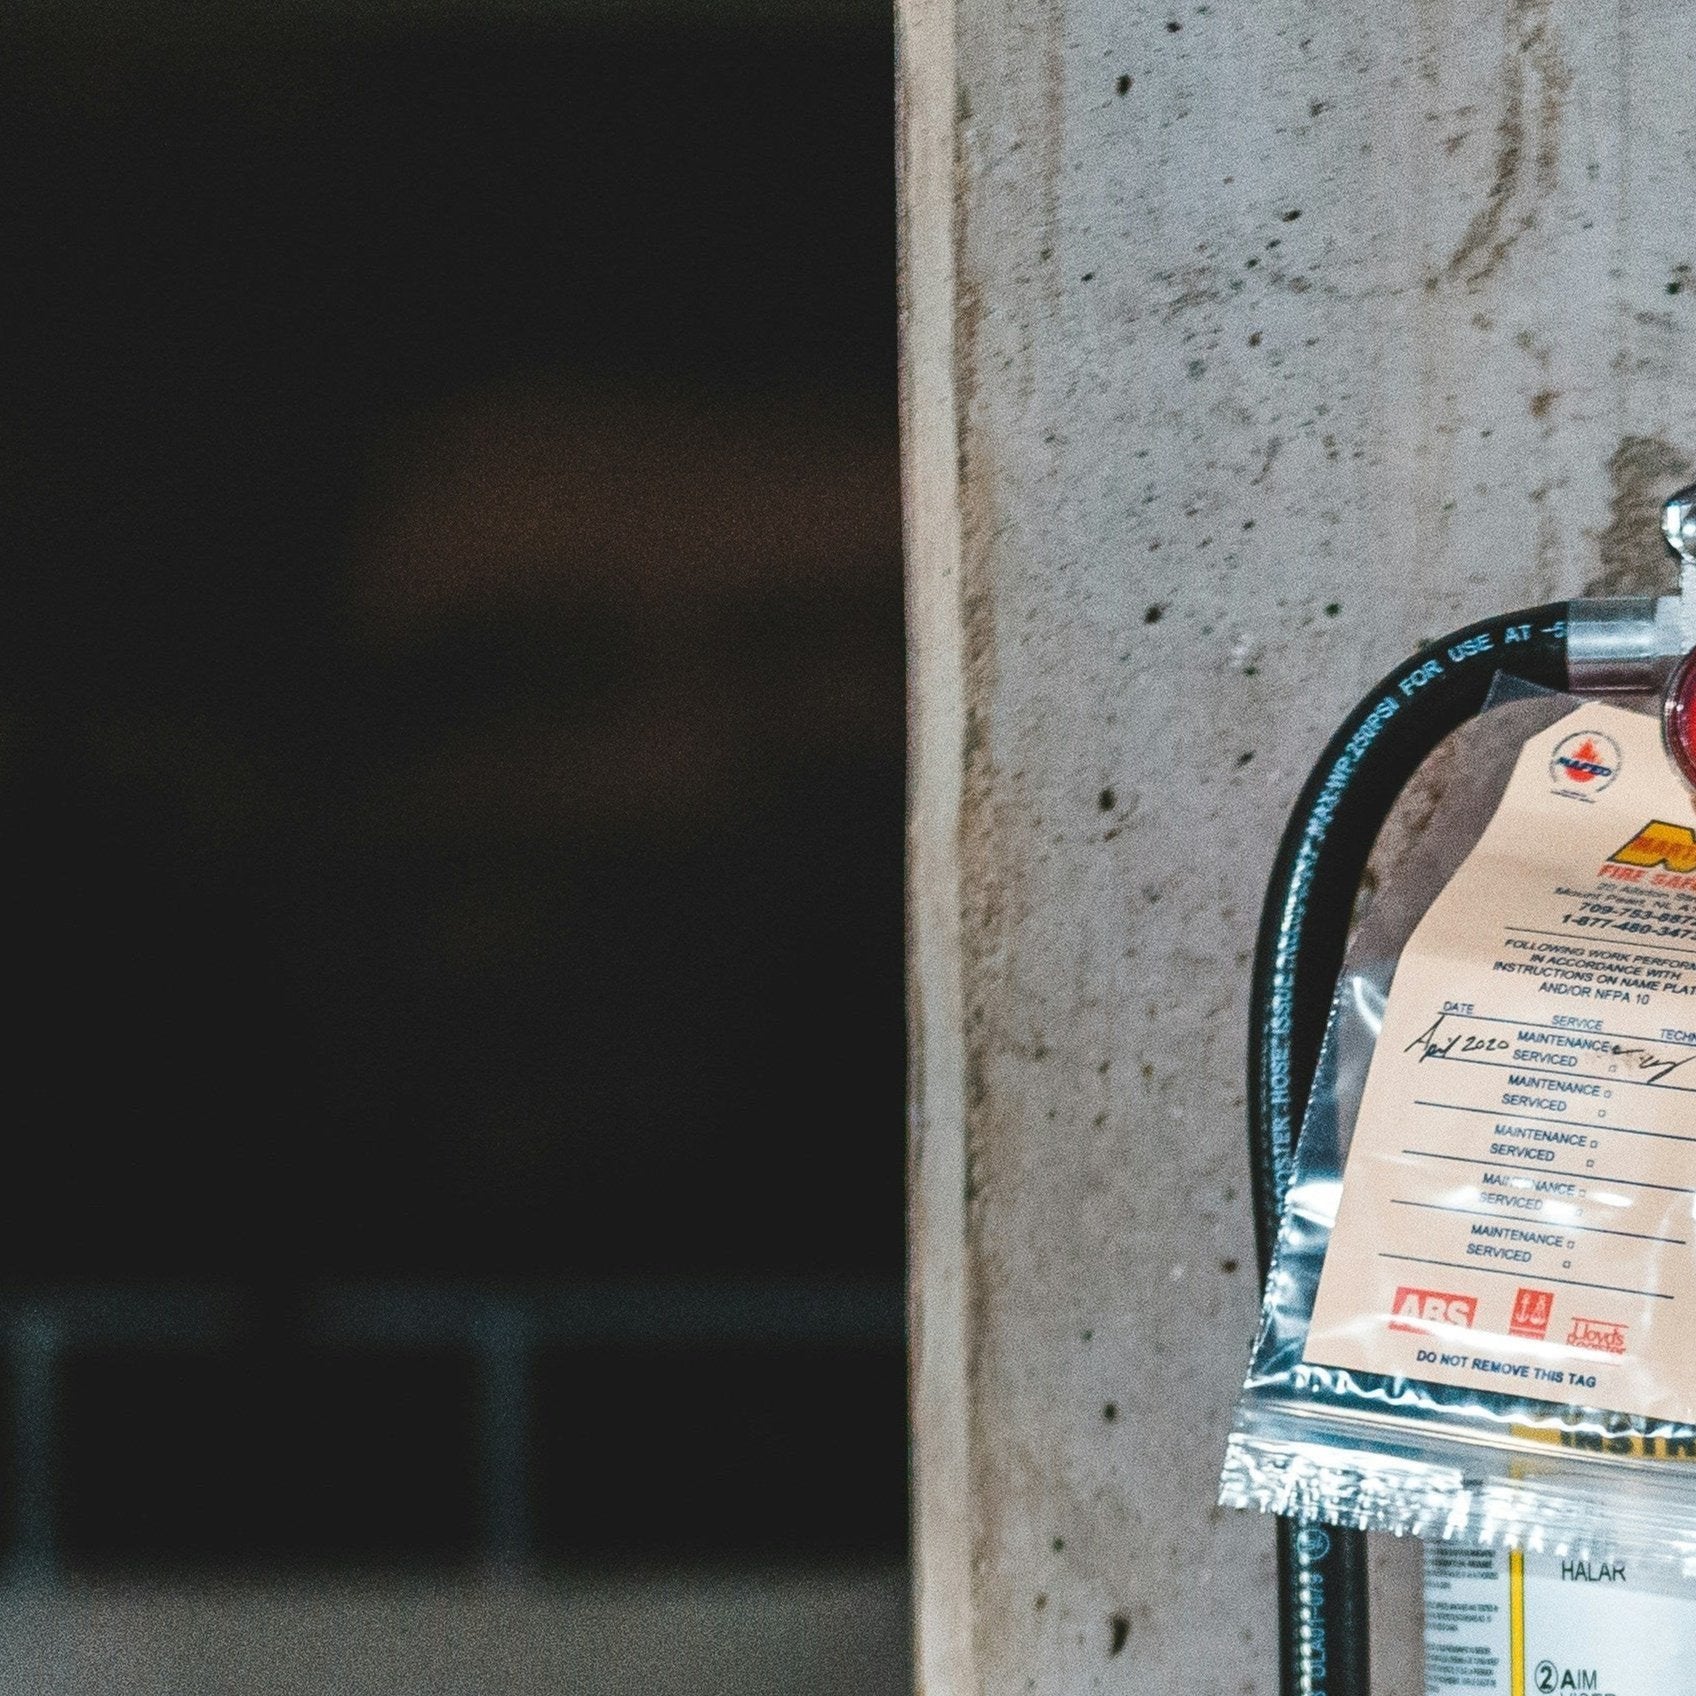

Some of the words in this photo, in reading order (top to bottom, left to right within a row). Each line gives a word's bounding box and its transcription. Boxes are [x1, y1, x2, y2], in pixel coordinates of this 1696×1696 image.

[1398, 658, 1444, 697] FOR
[1447, 633, 1494, 663] USE
[1504, 624, 1532, 643] AT
[1597, 864, 1647, 883] FIRE
[1504, 939, 1585, 957] FOLLOWING
[1588, 949, 1631, 963] WORK
[1493, 961, 1594, 983] INSTRUCTIONS
[1596, 974, 1617, 985] ON
[1620, 977, 1660, 991] NAME
[1530, 953, 1544, 964] IN
[1546, 956, 1641, 976] ACCORDANCE
[1646, 968, 1682, 981] WITH
[1538, 981, 1592, 998] AND/OR
[1595, 989, 1631, 1004] NFPA
[1636, 993, 1650, 1005] 10
[1443, 1001, 1474, 1015] DATE
[1552, 1014, 1604, 1030] SERVICE
[1461, 1036, 1509, 1052] 2020
[1517, 1030, 1610, 1053] MAINTENANCE
[1513, 1049, 1578, 1067] SERVICED
[1508, 1074, 1600, 1097] MAINTENANCE
[1501, 1093, 1567, 1112] SERVICED
[1494, 1124, 1587, 1147] MAINTENANCE
[1490, 1142, 1555, 1162] SERVICED
[1480, 1191, 1543, 1211] SERVICED
[1471, 1224, 1564, 1248] MAINTENANCE
[1466, 1243, 1532, 1263] SERVICED
[1399, 1293, 1470, 1329] ABS
[1416, 1349, 1437, 1364] DO
[1440, 1353, 1469, 1368] NOT
[1472, 1358, 1530, 1379] REMOVE
[1533, 1367, 1564, 1384] THIS
[1568, 1373, 1597, 1388] TAG
[1560, 1558, 1628, 1583] HALAR
[1560, 1668, 1597, 1690] AIM
